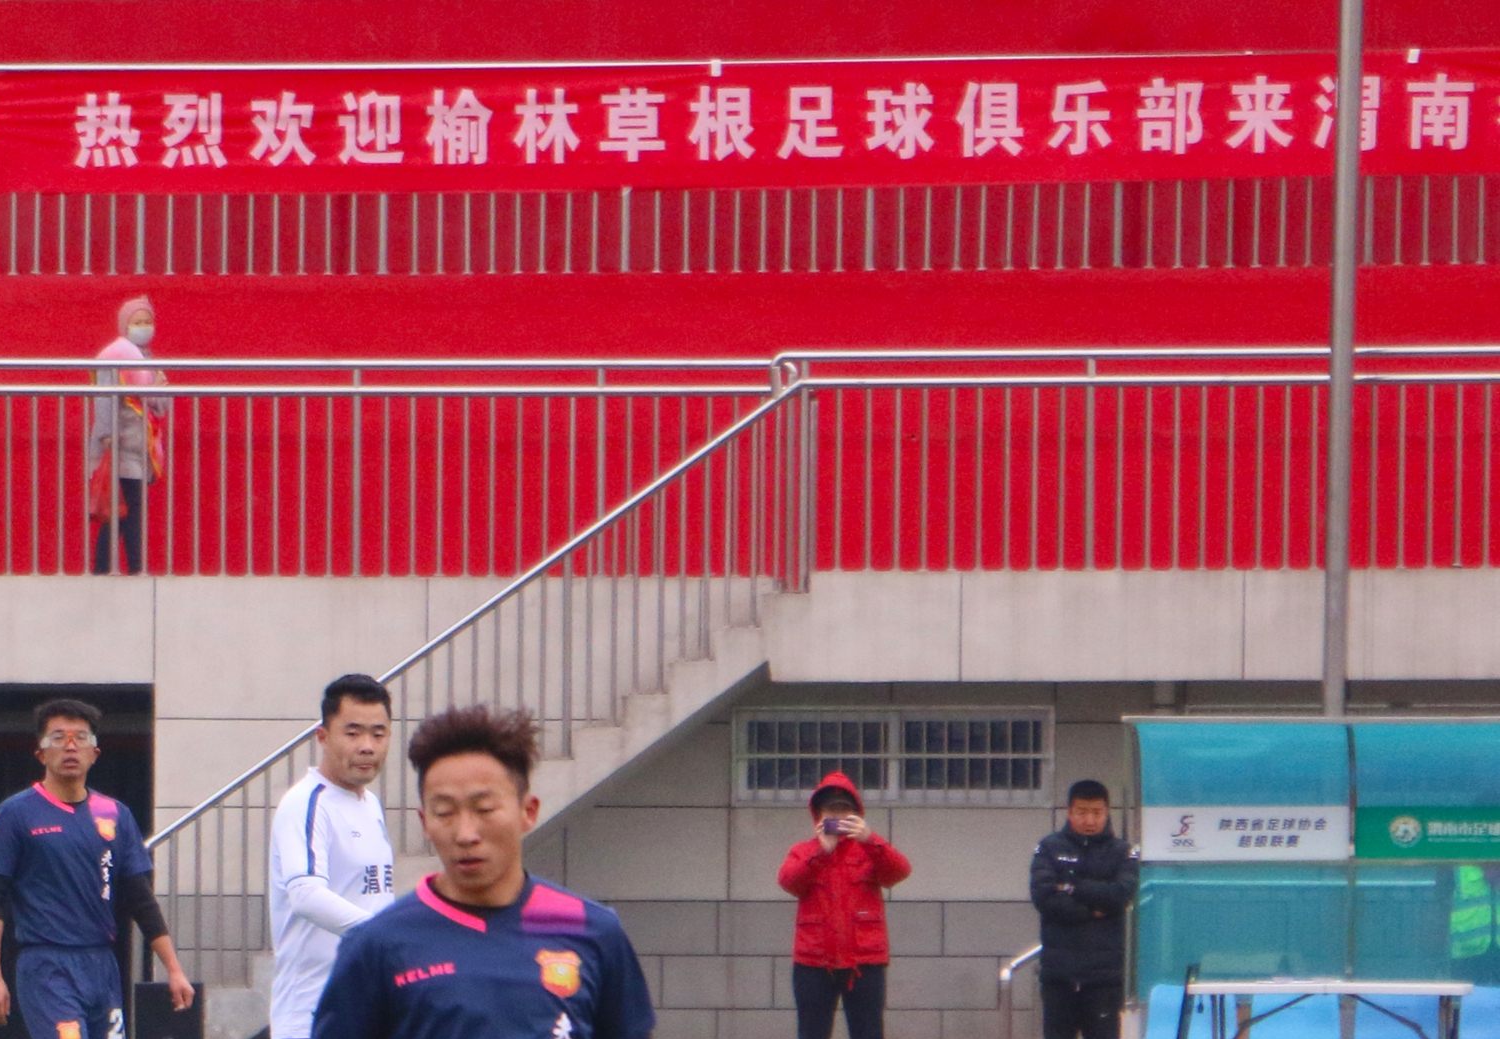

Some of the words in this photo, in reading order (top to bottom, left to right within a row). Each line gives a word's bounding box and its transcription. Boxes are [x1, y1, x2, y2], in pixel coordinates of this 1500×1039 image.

[31, 826, 63, 836] KELME
[1218, 818, 1327, 831] 陕西省足球协会
[1238, 835, 1300, 848] 超级联赛
[394, 962, 456, 988] KELME
